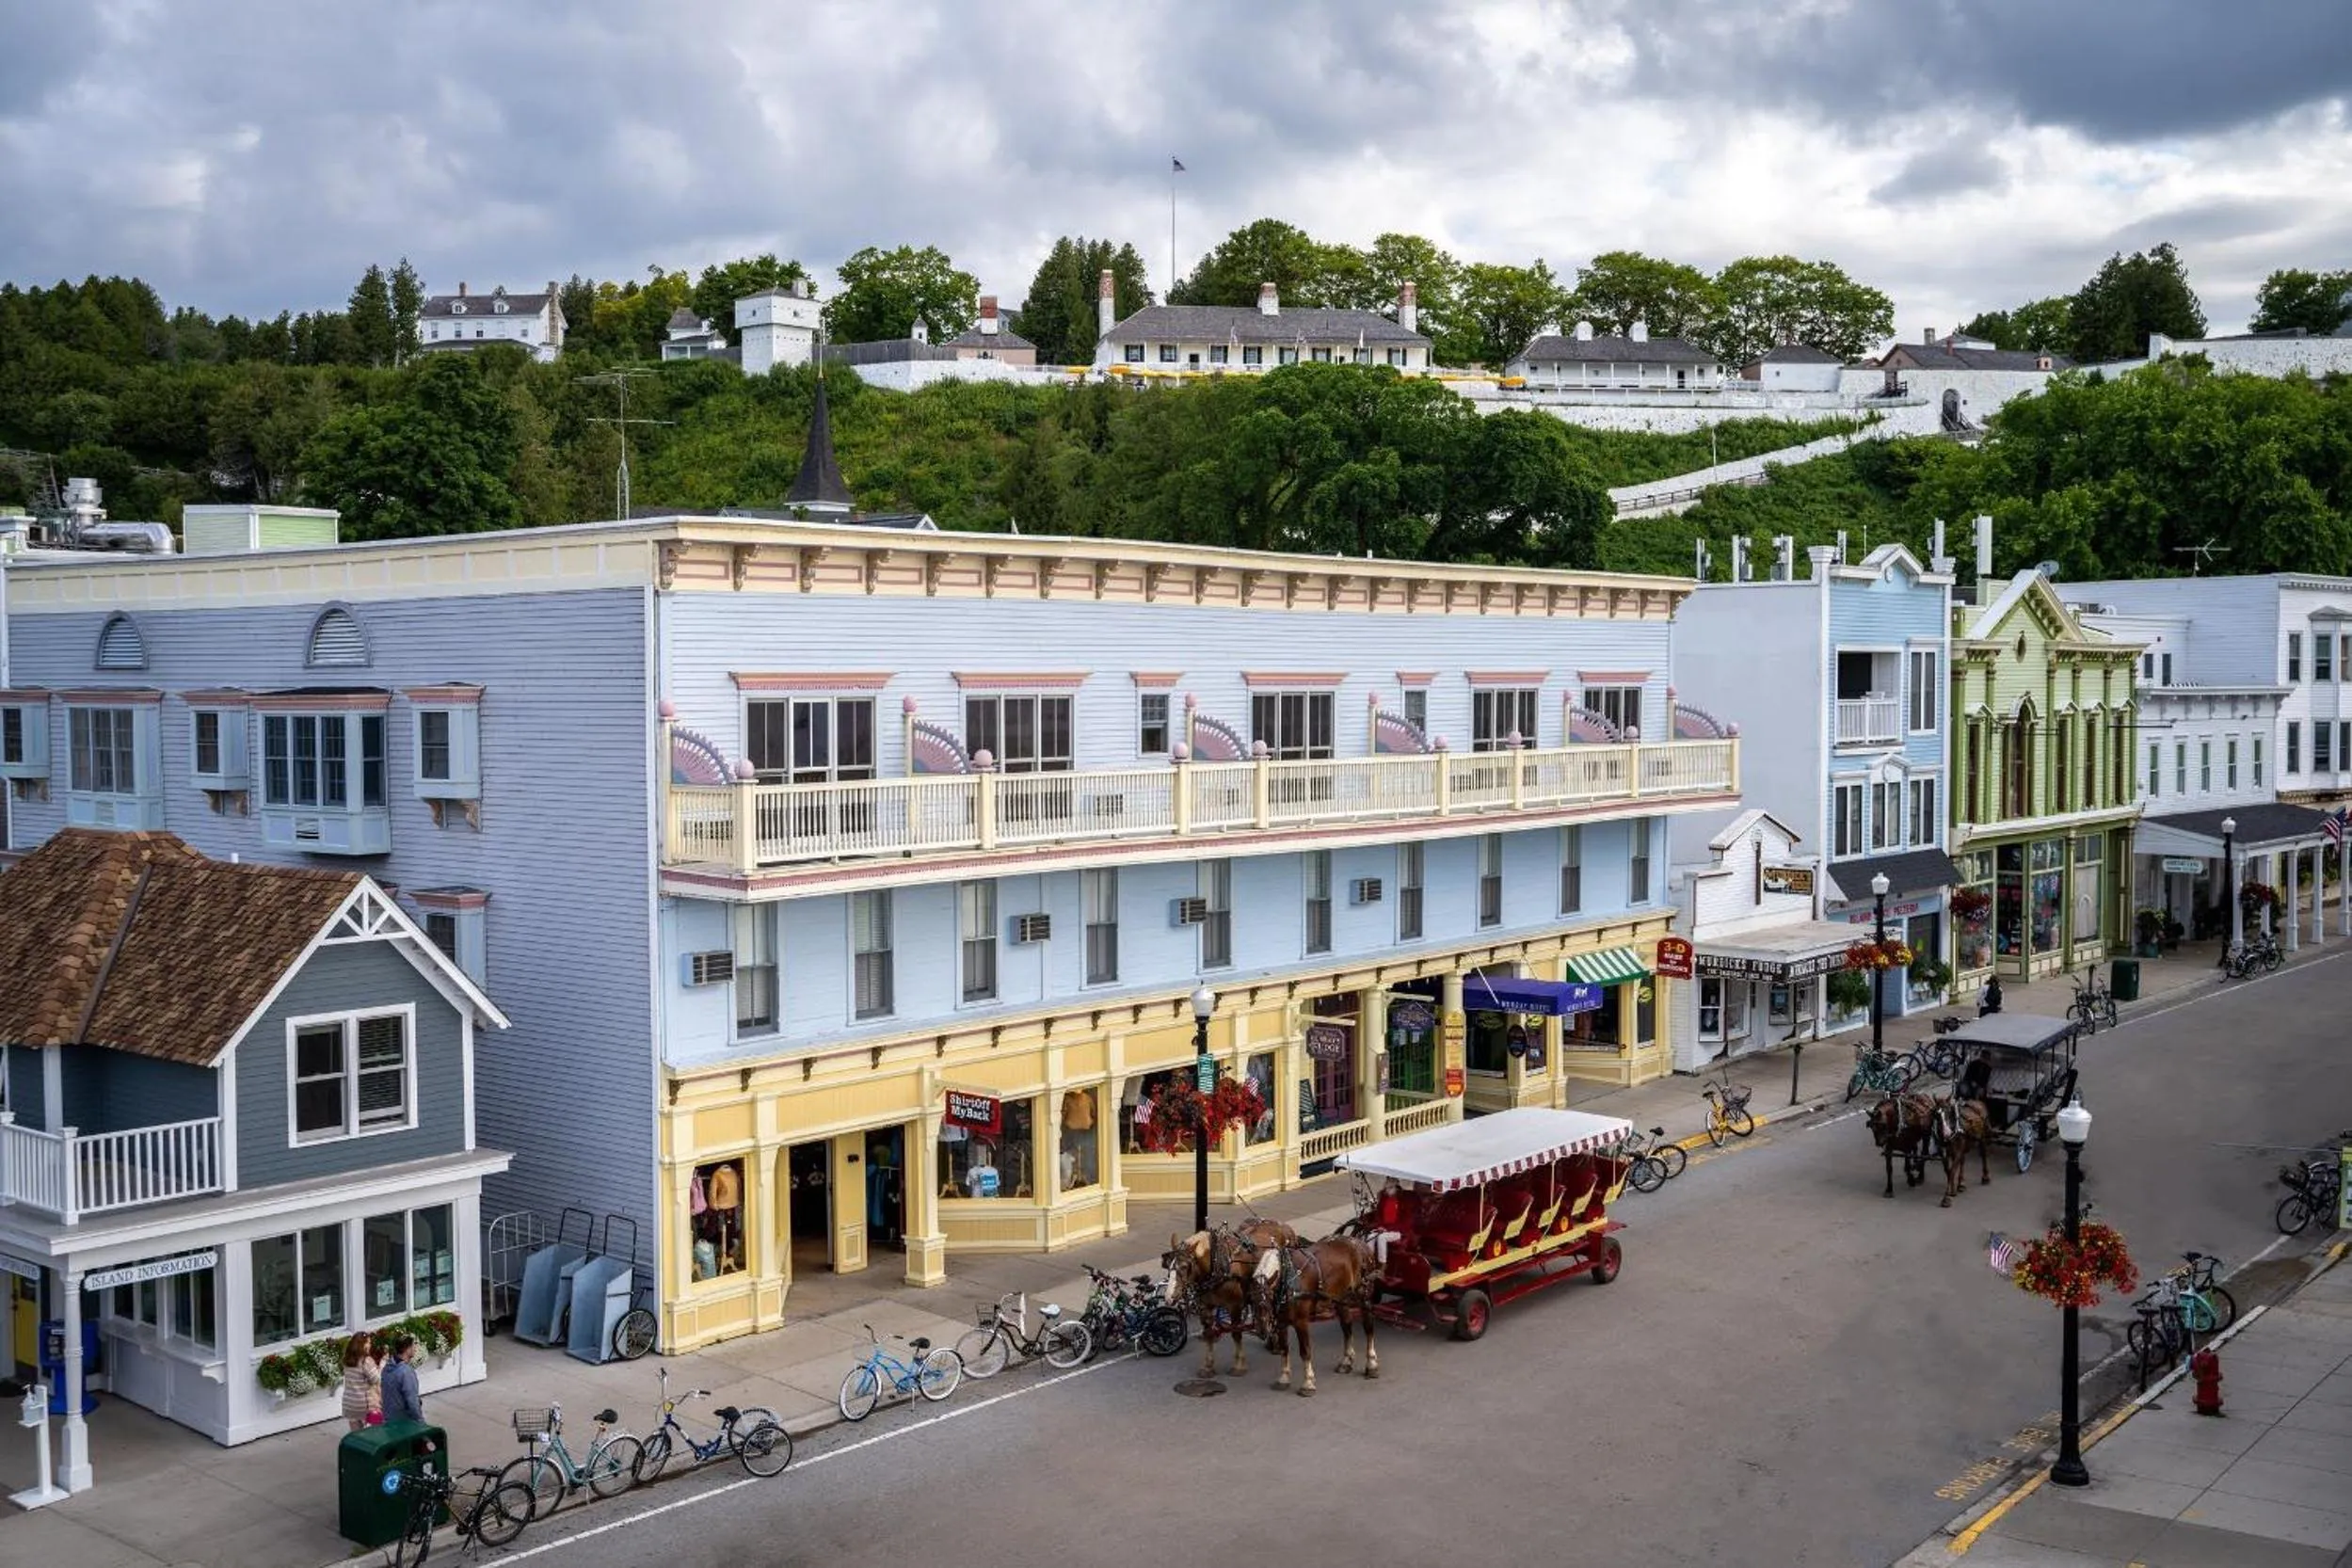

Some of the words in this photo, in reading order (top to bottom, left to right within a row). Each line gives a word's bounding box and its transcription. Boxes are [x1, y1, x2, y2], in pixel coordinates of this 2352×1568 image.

[1663, 941, 1686, 953] 3-D
[1752, 960, 1783, 974] FUDGE
[91, 1271, 133, 1288] ISLAND
[138, 1255, 214, 1279] INFORMATION
